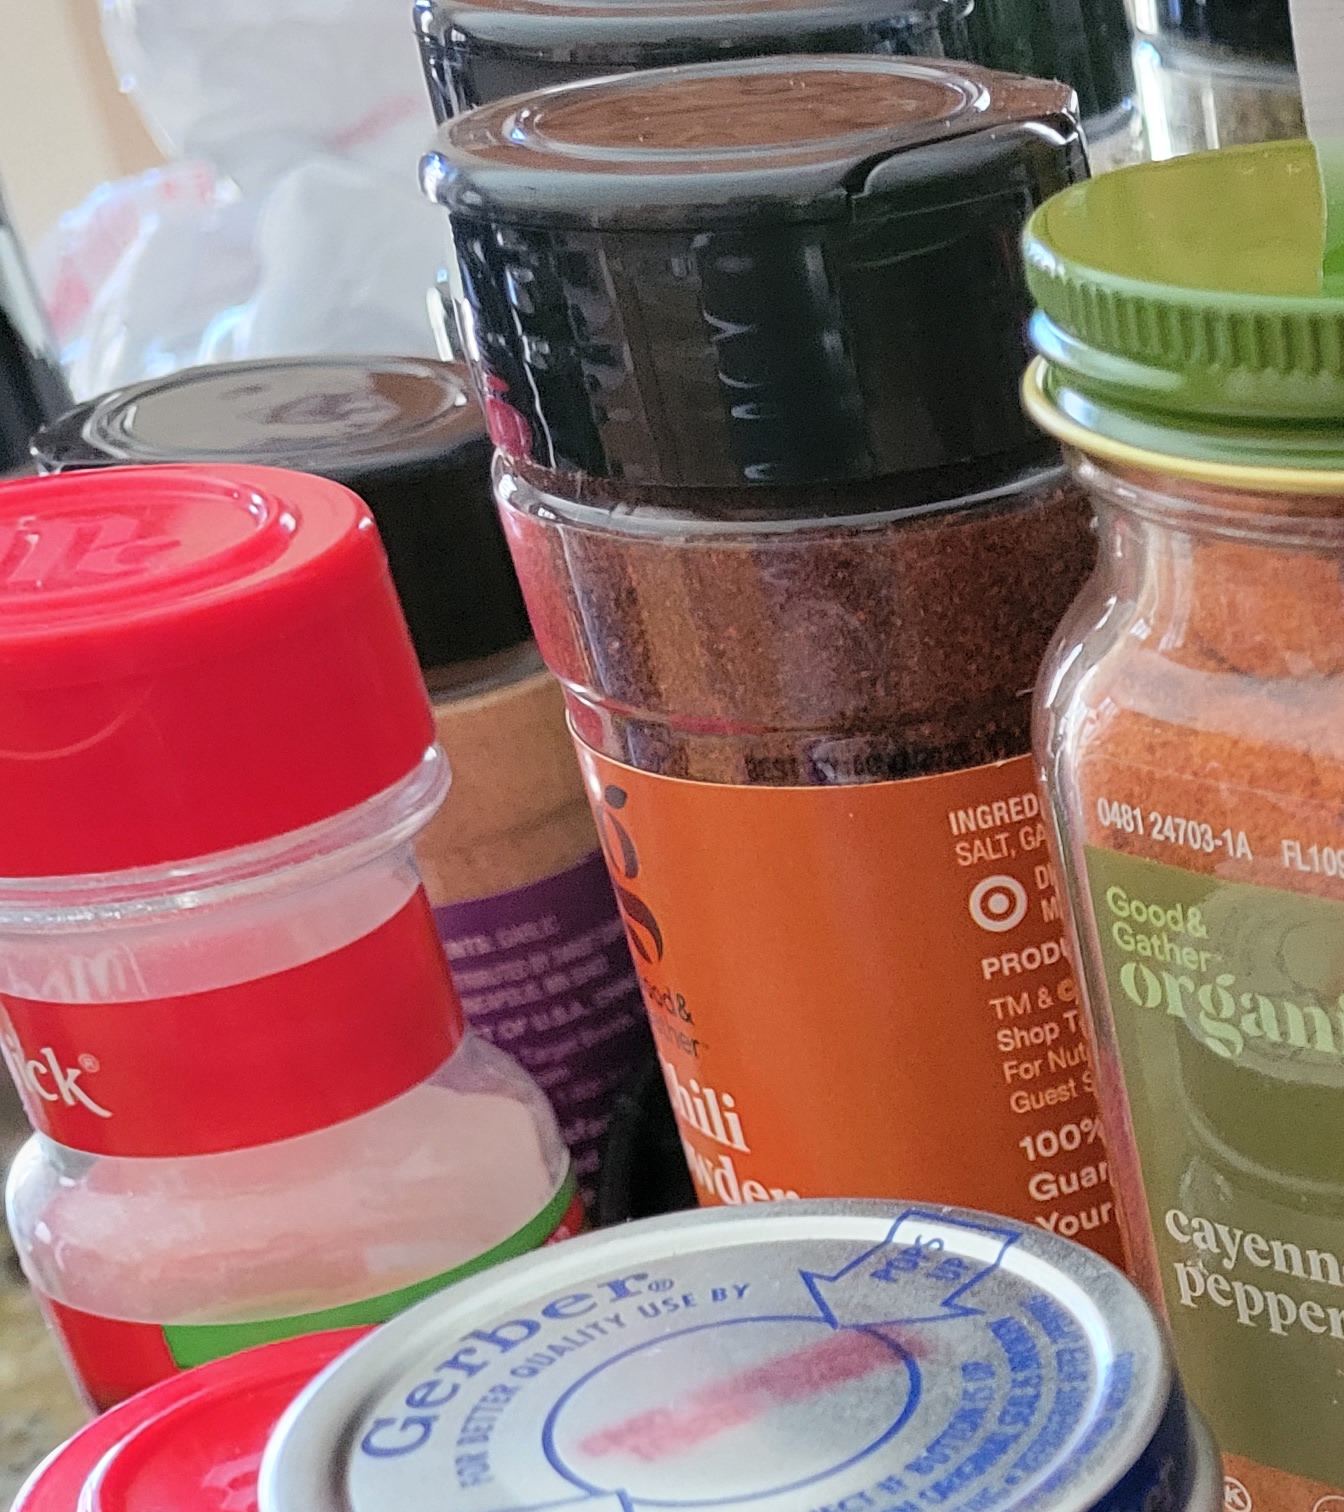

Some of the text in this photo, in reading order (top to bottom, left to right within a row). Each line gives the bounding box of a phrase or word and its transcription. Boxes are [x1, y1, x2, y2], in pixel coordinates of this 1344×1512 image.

[949, 793, 1040, 836] INGRED
[1097, 797, 1145, 836] 0481
[1148, 811, 1253, 861] 24703-1A
[955, 832, 1017, 867] SALT,
[996, 1021, 1060, 1052] Shop
[1002, 1042, 1089, 1084] For Nut
[664, 1062, 751, 1154] hili
[1009, 1079, 1078, 1114] Guest
[1028, 1160, 1110, 1201] Guar
[456, 1383, 520, 1449] BETTER
[509, 1313, 627, 1380] QUALITY
[637, 1292, 697, 1319] USE
[711, 1282, 752, 1302] BY
